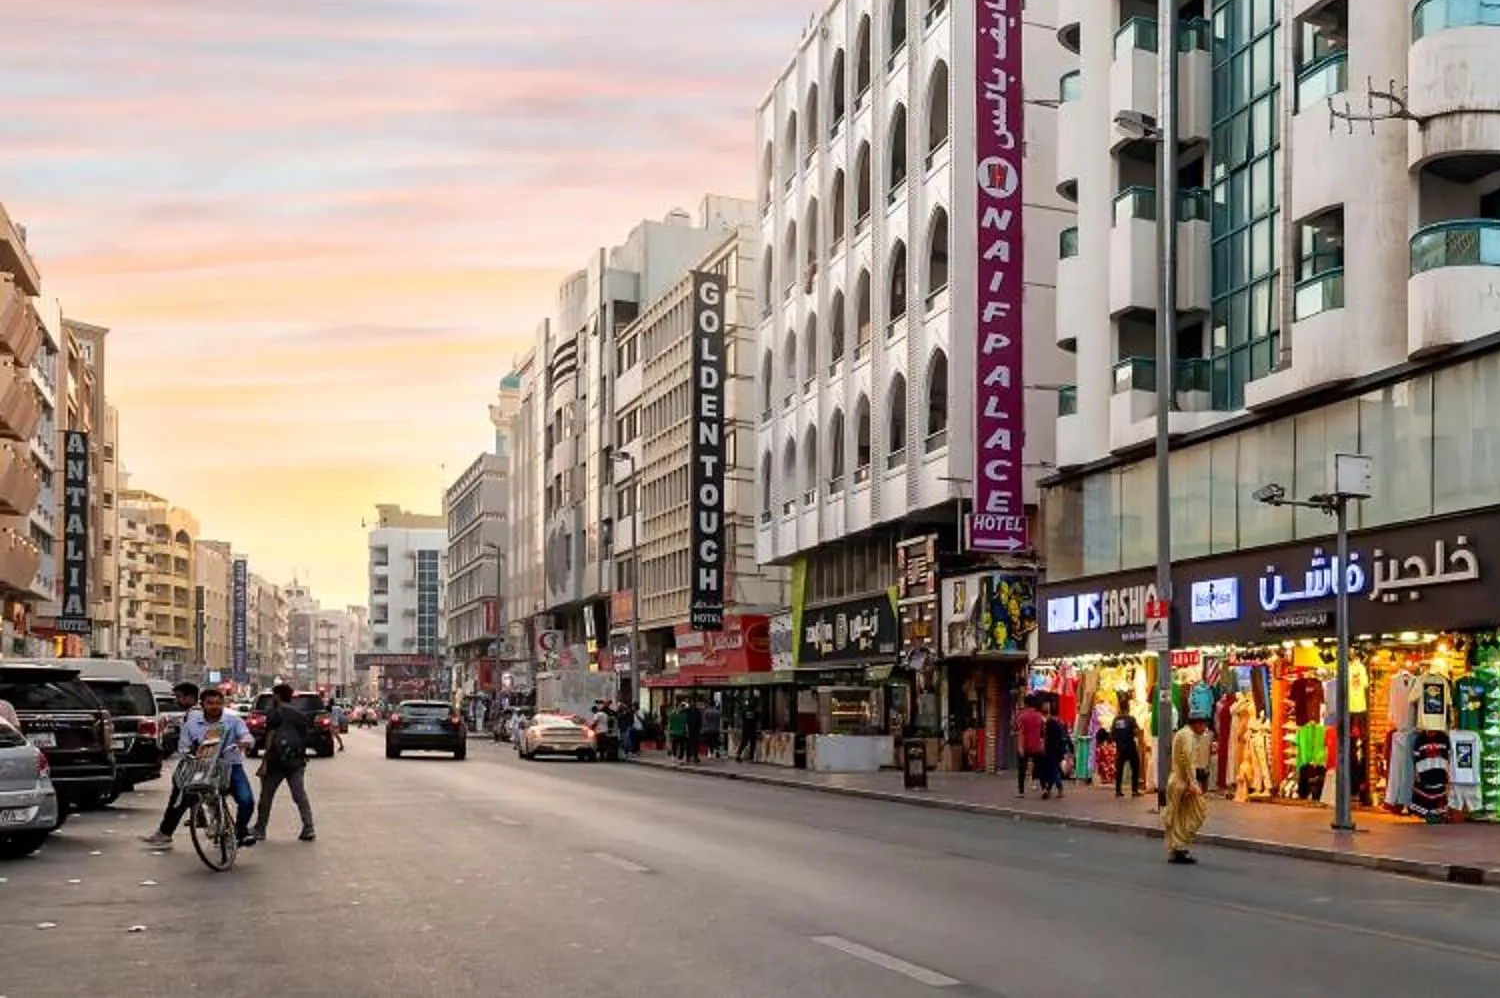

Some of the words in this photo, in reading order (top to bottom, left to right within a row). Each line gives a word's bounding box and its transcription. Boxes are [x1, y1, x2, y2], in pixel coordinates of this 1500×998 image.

[699, 281, 719, 447] GOLDEN
[65, 433, 86, 615] ANTALIA
[699, 455, 719, 592] TOUCH
[973, 515, 1024, 532] HOTEL
[1258, 546, 1365, 612] فاشن
[1369, 535, 1480, 602] خلجيز
[693, 613, 722, 623] HOTEL
